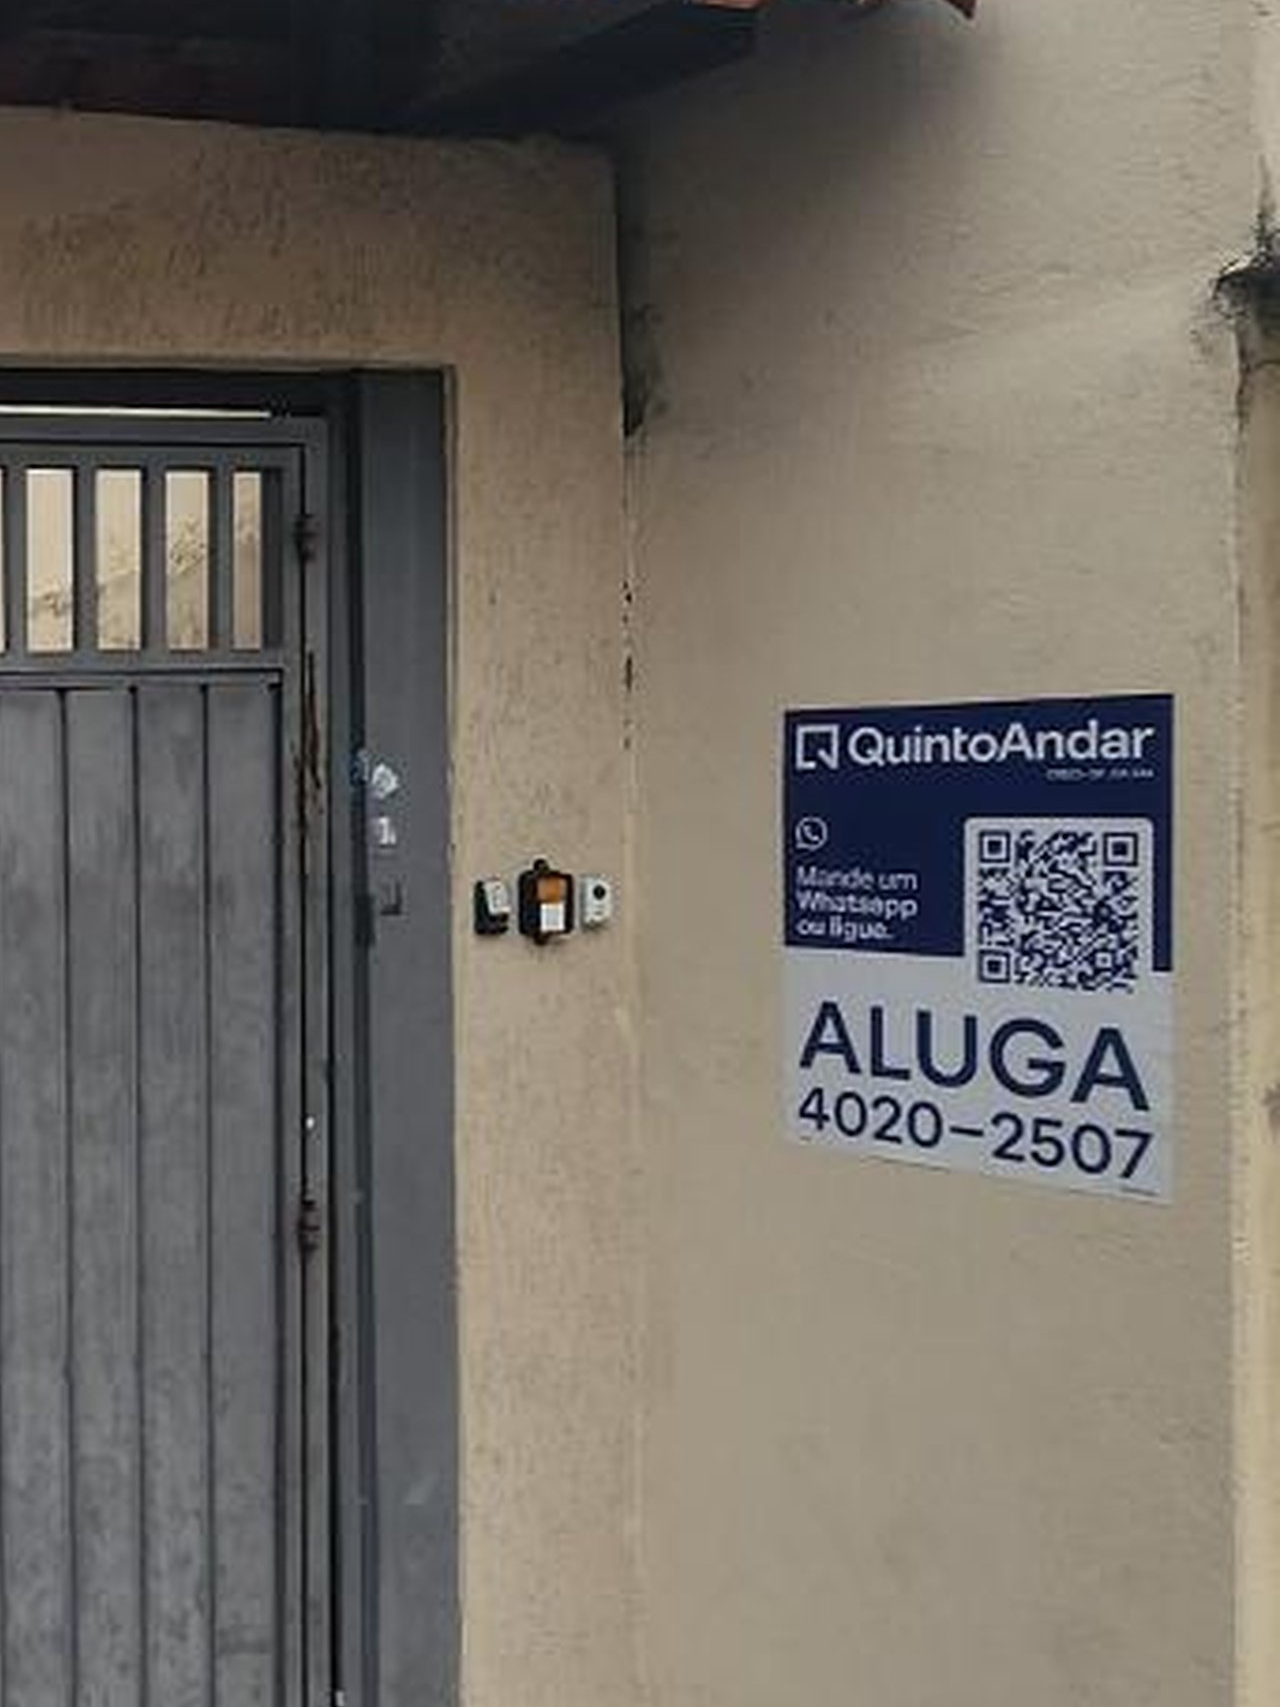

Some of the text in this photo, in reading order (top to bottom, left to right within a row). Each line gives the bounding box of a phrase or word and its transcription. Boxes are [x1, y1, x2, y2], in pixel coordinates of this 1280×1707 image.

[848, 719, 1155, 766] QuintoAndar
[878, 872, 918, 891] um
[799, 1001, 1150, 1112] ALUGA
[798, 1087, 1154, 1179] 4020-2507
